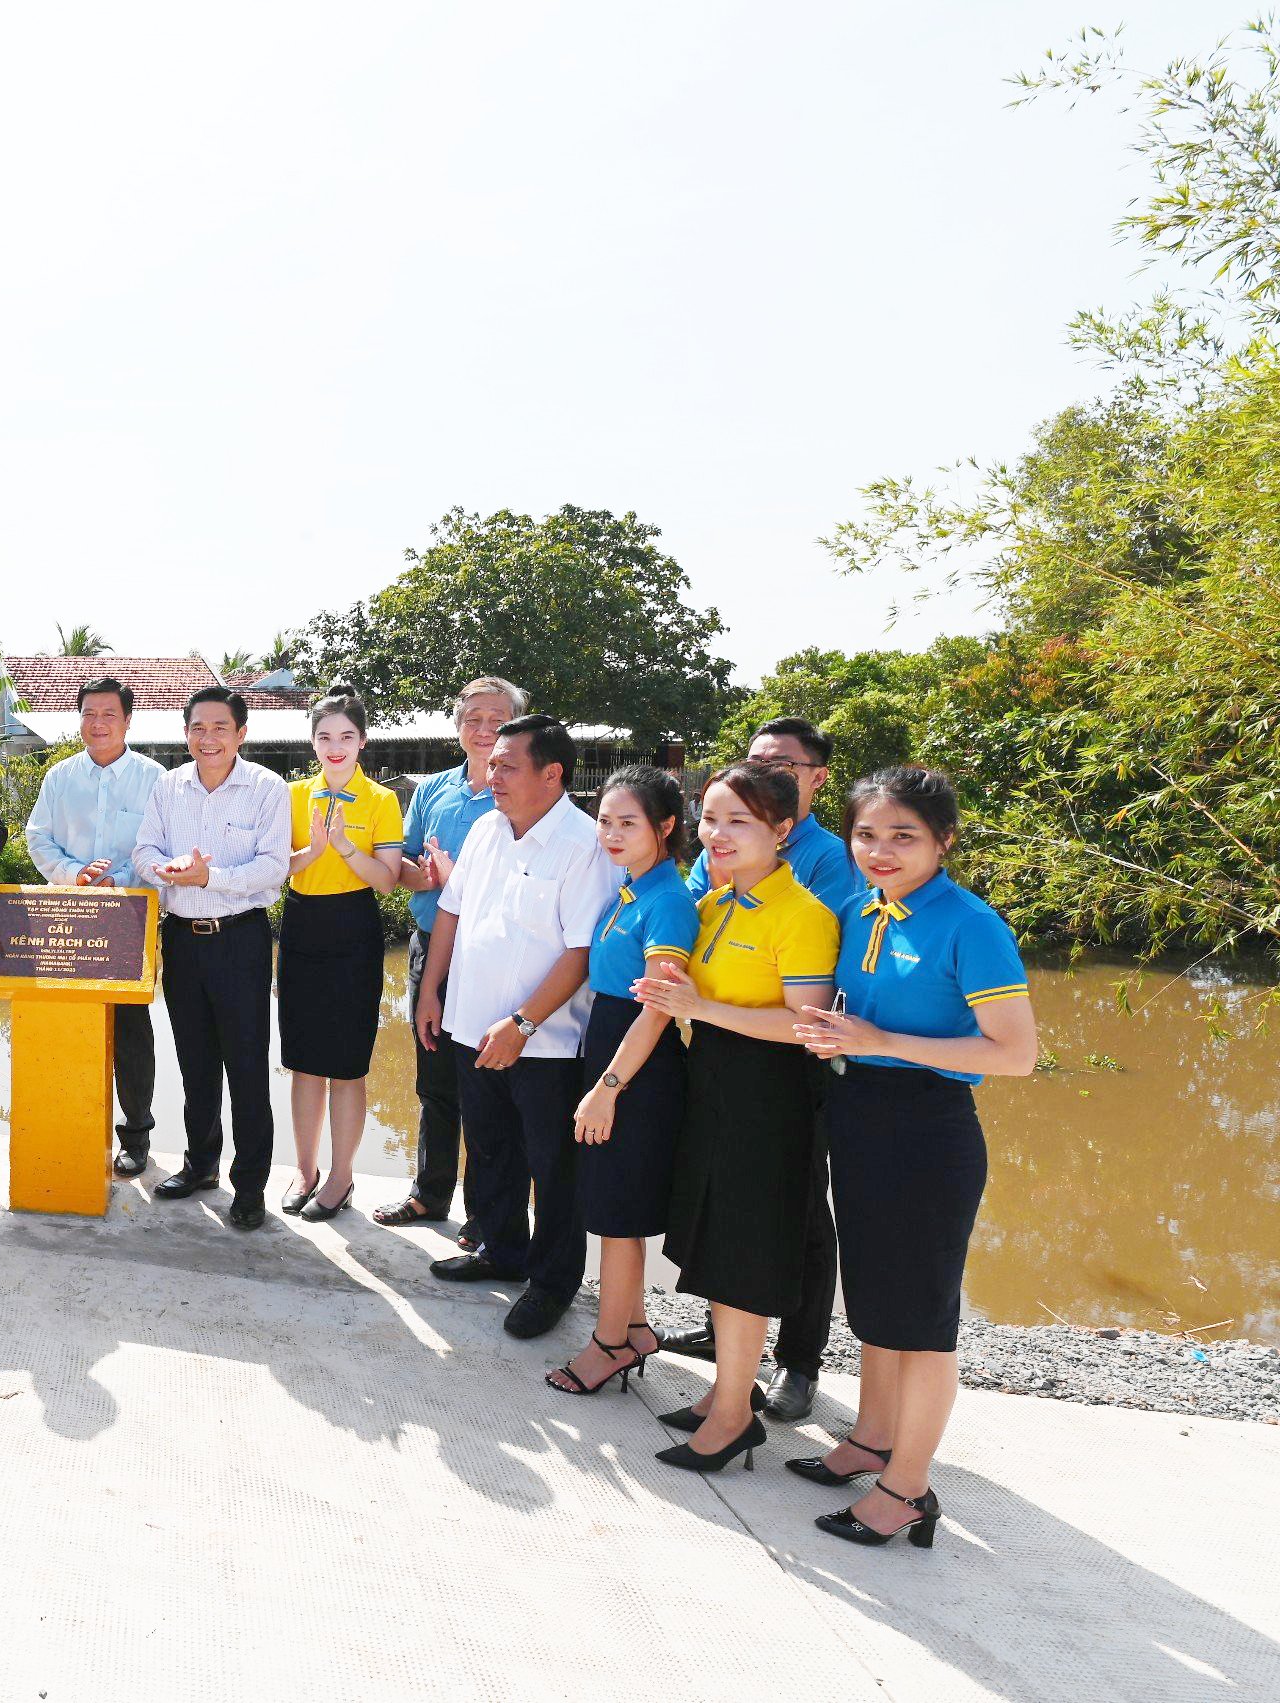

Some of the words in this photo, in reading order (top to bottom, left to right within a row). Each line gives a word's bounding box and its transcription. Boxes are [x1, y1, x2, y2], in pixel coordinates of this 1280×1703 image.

[100, 900, 121, 908] THÔN
[9, 934, 45, 946] KÊNH
[48, 937, 83, 949] RẠCH
[86, 936, 109, 949] CỐI
